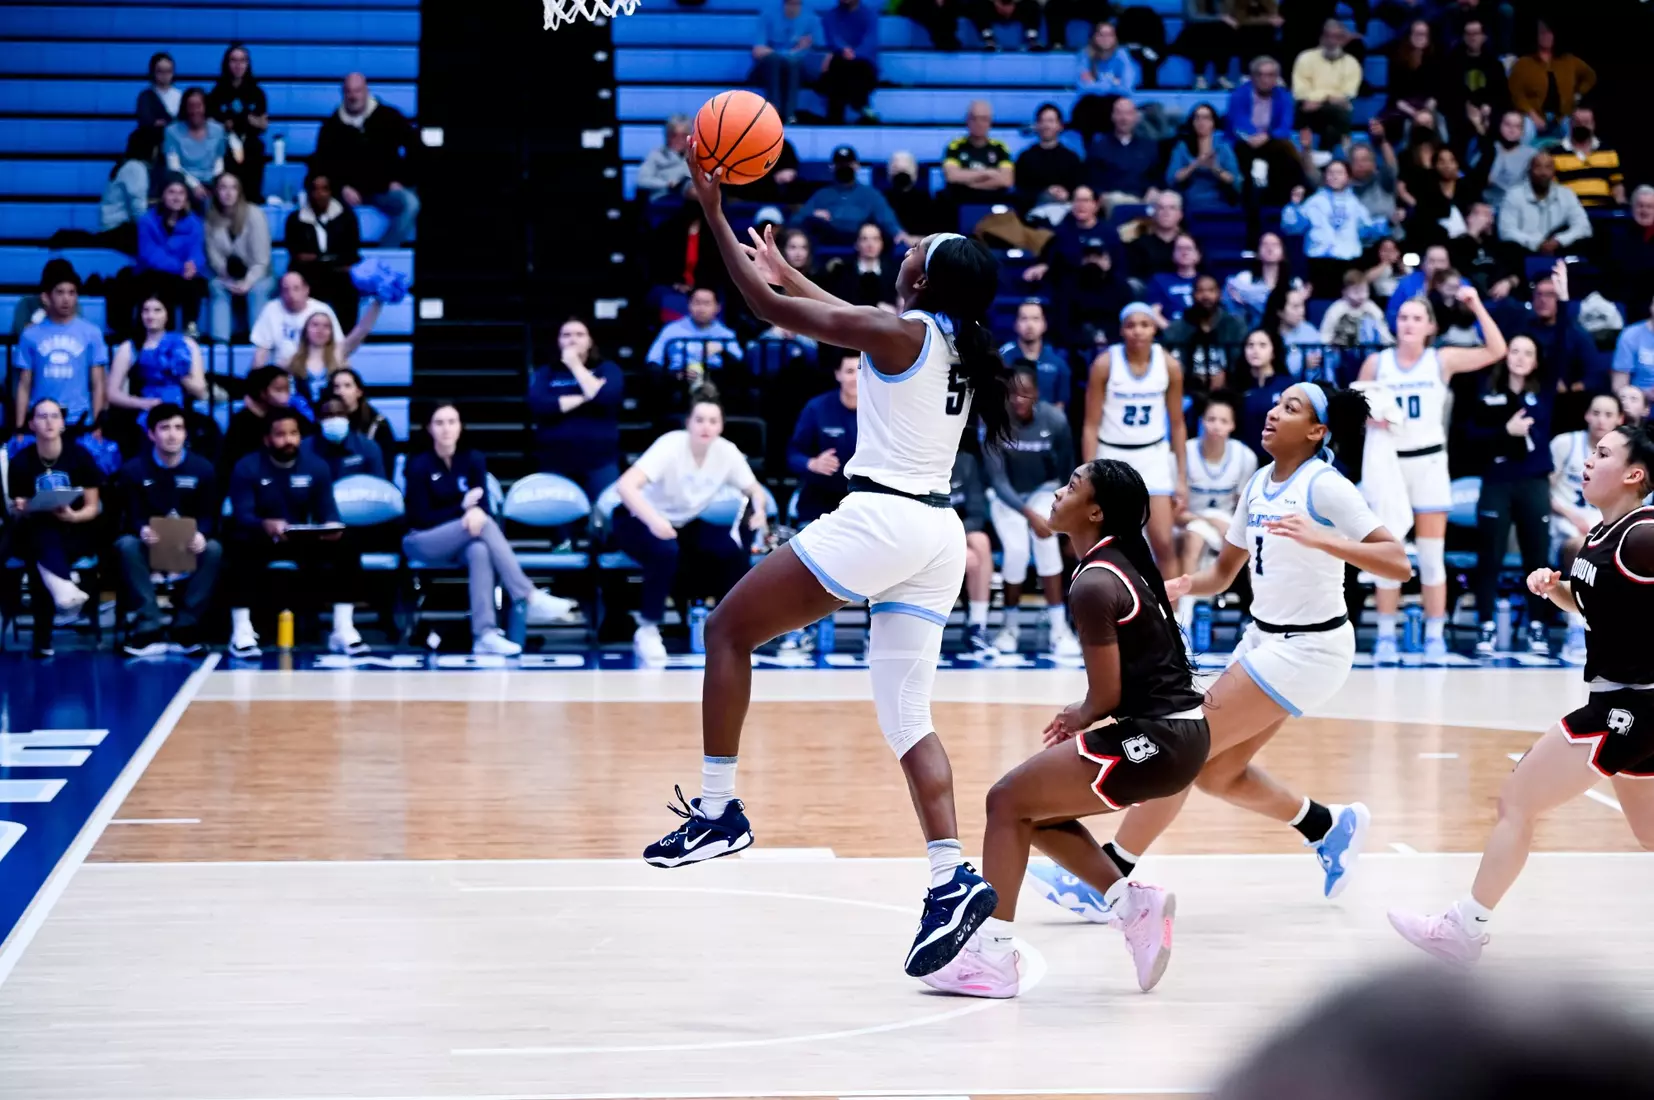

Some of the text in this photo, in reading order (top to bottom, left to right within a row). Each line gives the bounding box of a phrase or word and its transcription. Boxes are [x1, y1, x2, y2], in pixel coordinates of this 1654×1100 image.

[946, 363, 968, 416] 5
[1122, 405, 1152, 427] 23
[1255, 535, 1264, 576] 1
[1121, 733, 1159, 764] B
